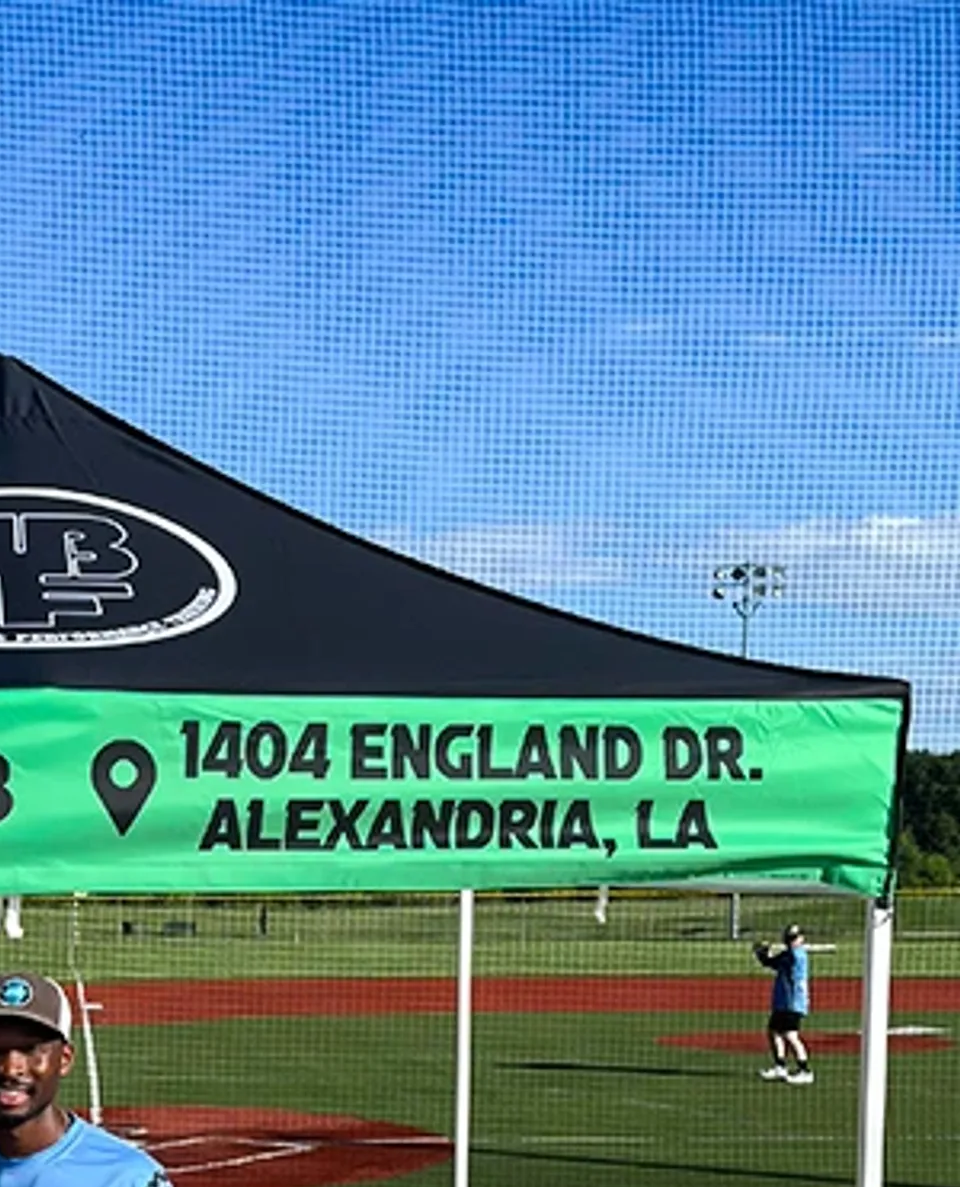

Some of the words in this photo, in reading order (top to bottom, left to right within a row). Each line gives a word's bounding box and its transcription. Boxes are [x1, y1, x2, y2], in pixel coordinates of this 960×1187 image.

[181, 720, 330, 779] 1404
[351, 723, 641, 779] ENGLAND
[664, 726, 763, 780] DR.
[200, 799, 616, 857] ALEXANDRIA,
[637, 799, 718, 850] LA
